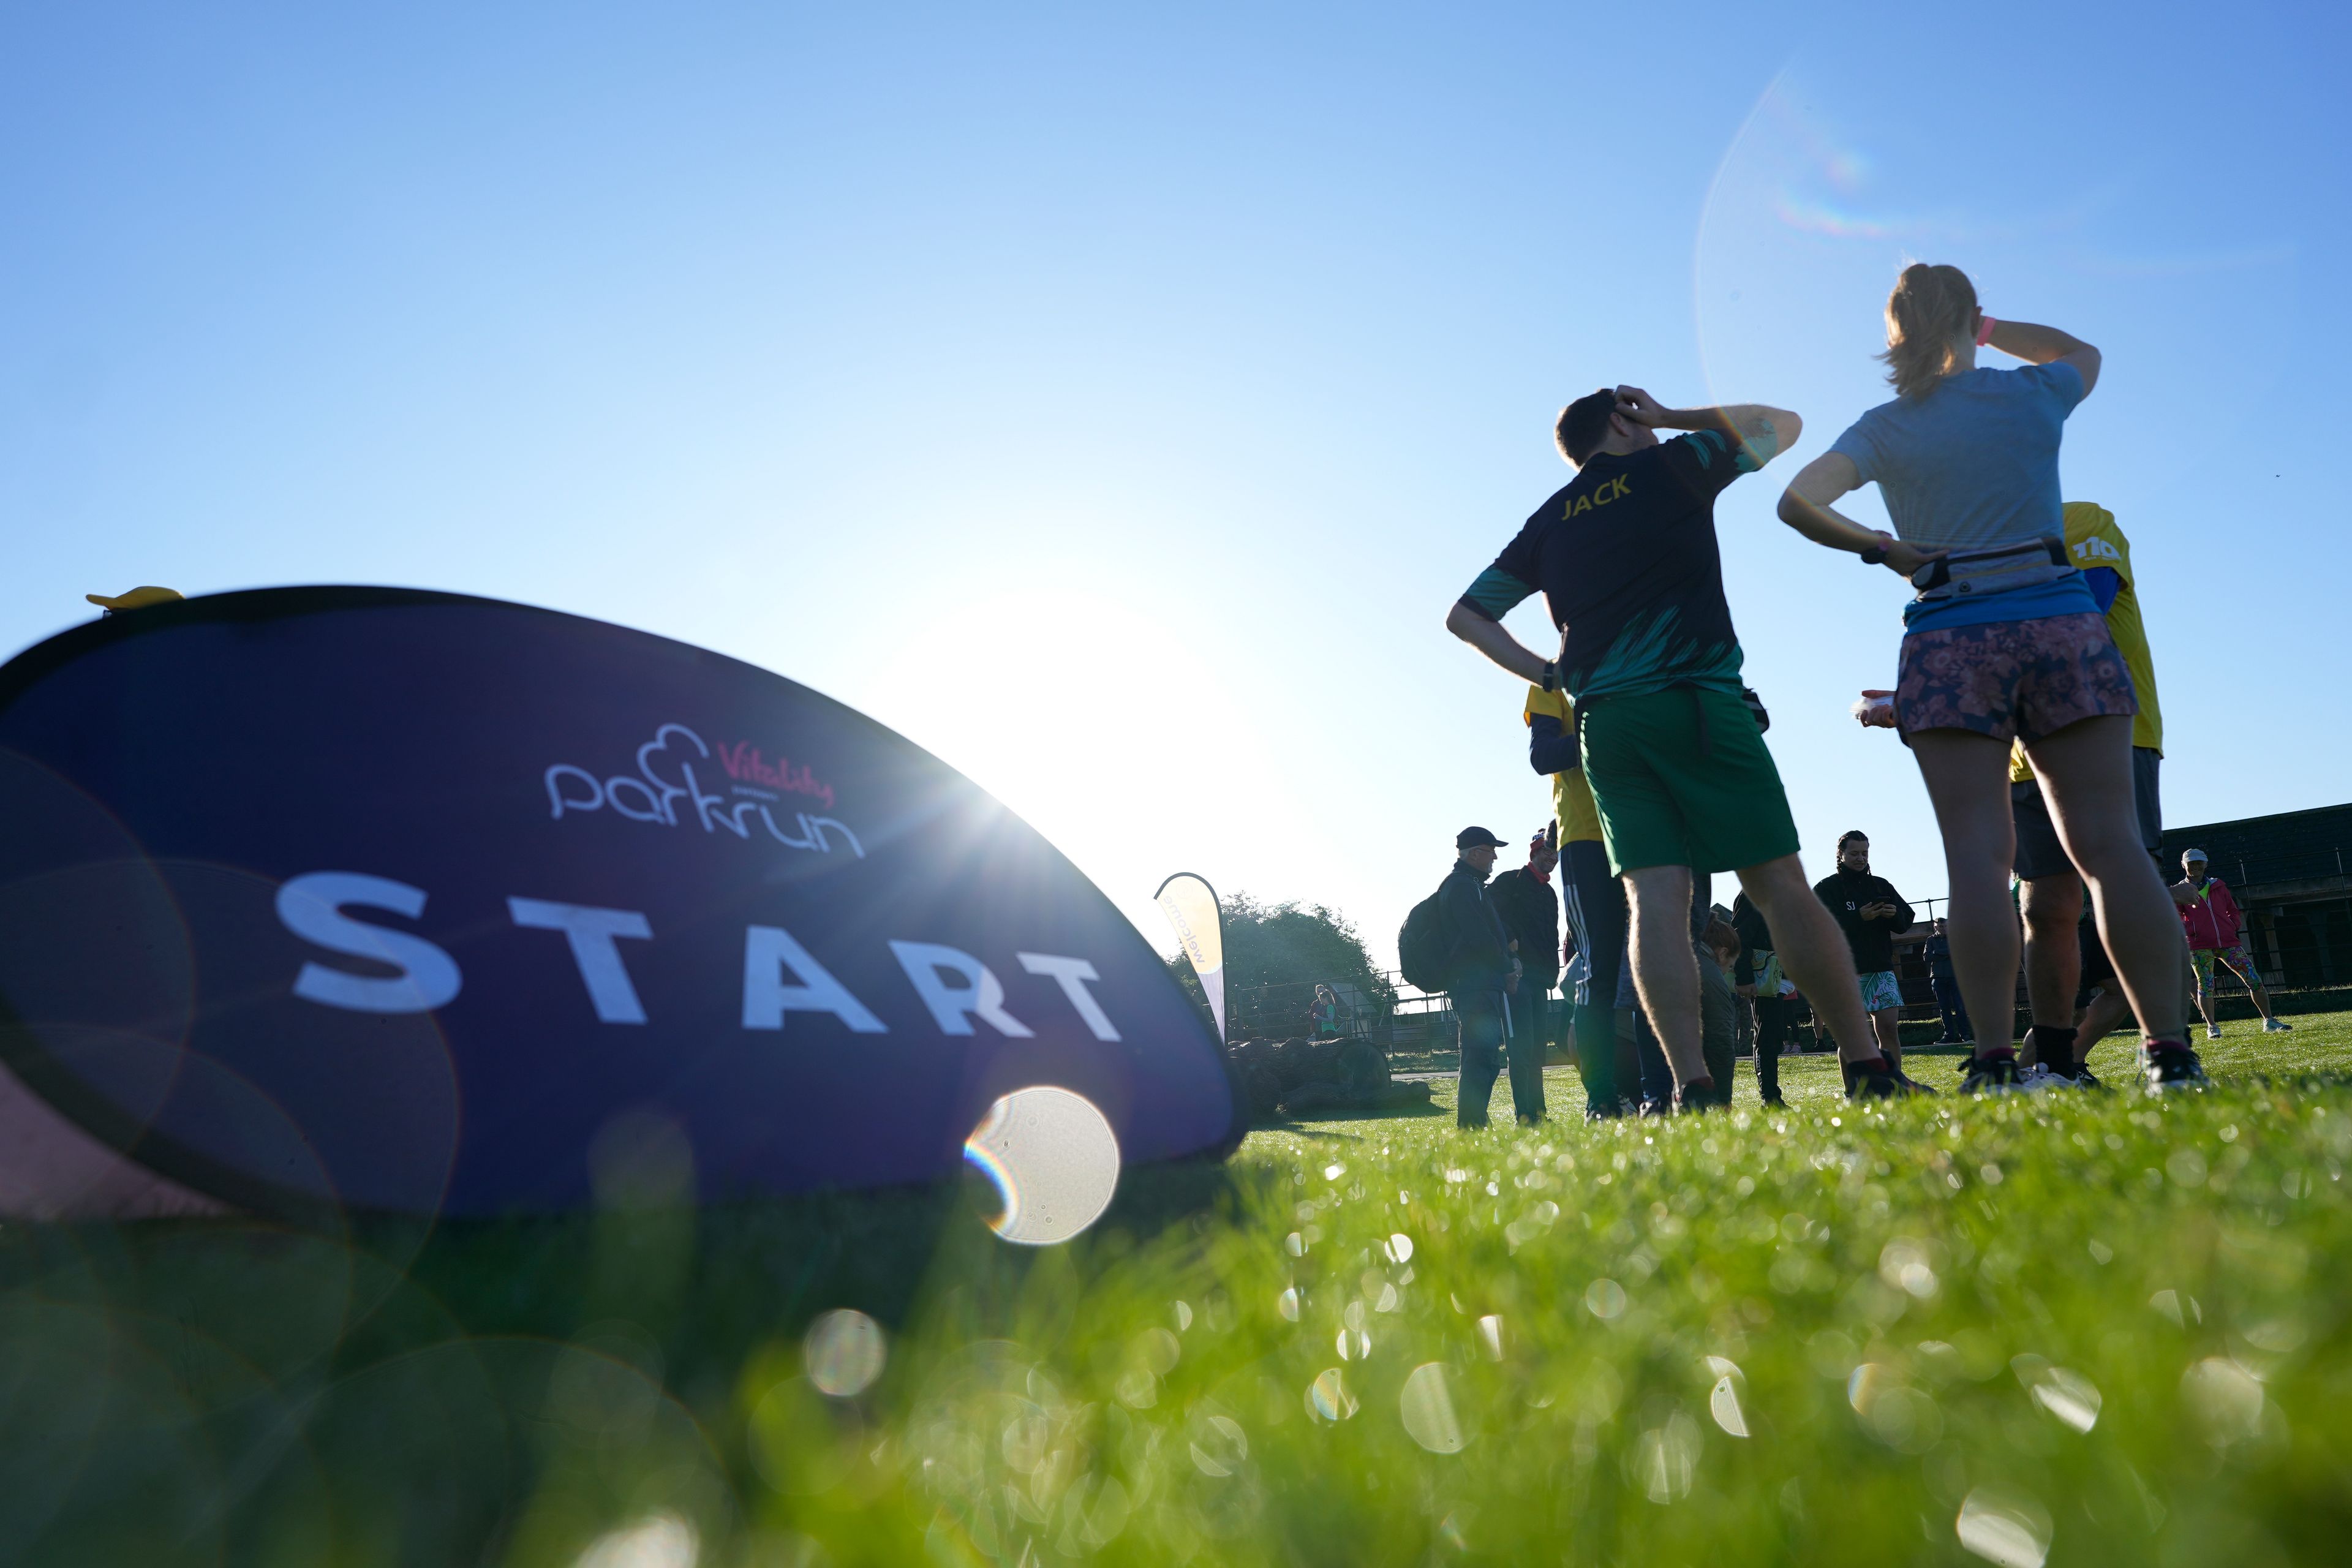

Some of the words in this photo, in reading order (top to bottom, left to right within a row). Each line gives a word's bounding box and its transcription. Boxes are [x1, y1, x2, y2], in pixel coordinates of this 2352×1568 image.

[1561, 473, 1632, 521] JACK
[544, 724, 865, 858] parkrun
[716, 740, 835, 810] Vitality
[1845, 901, 1856, 911] SJ
[276, 870, 1122, 1042] START
